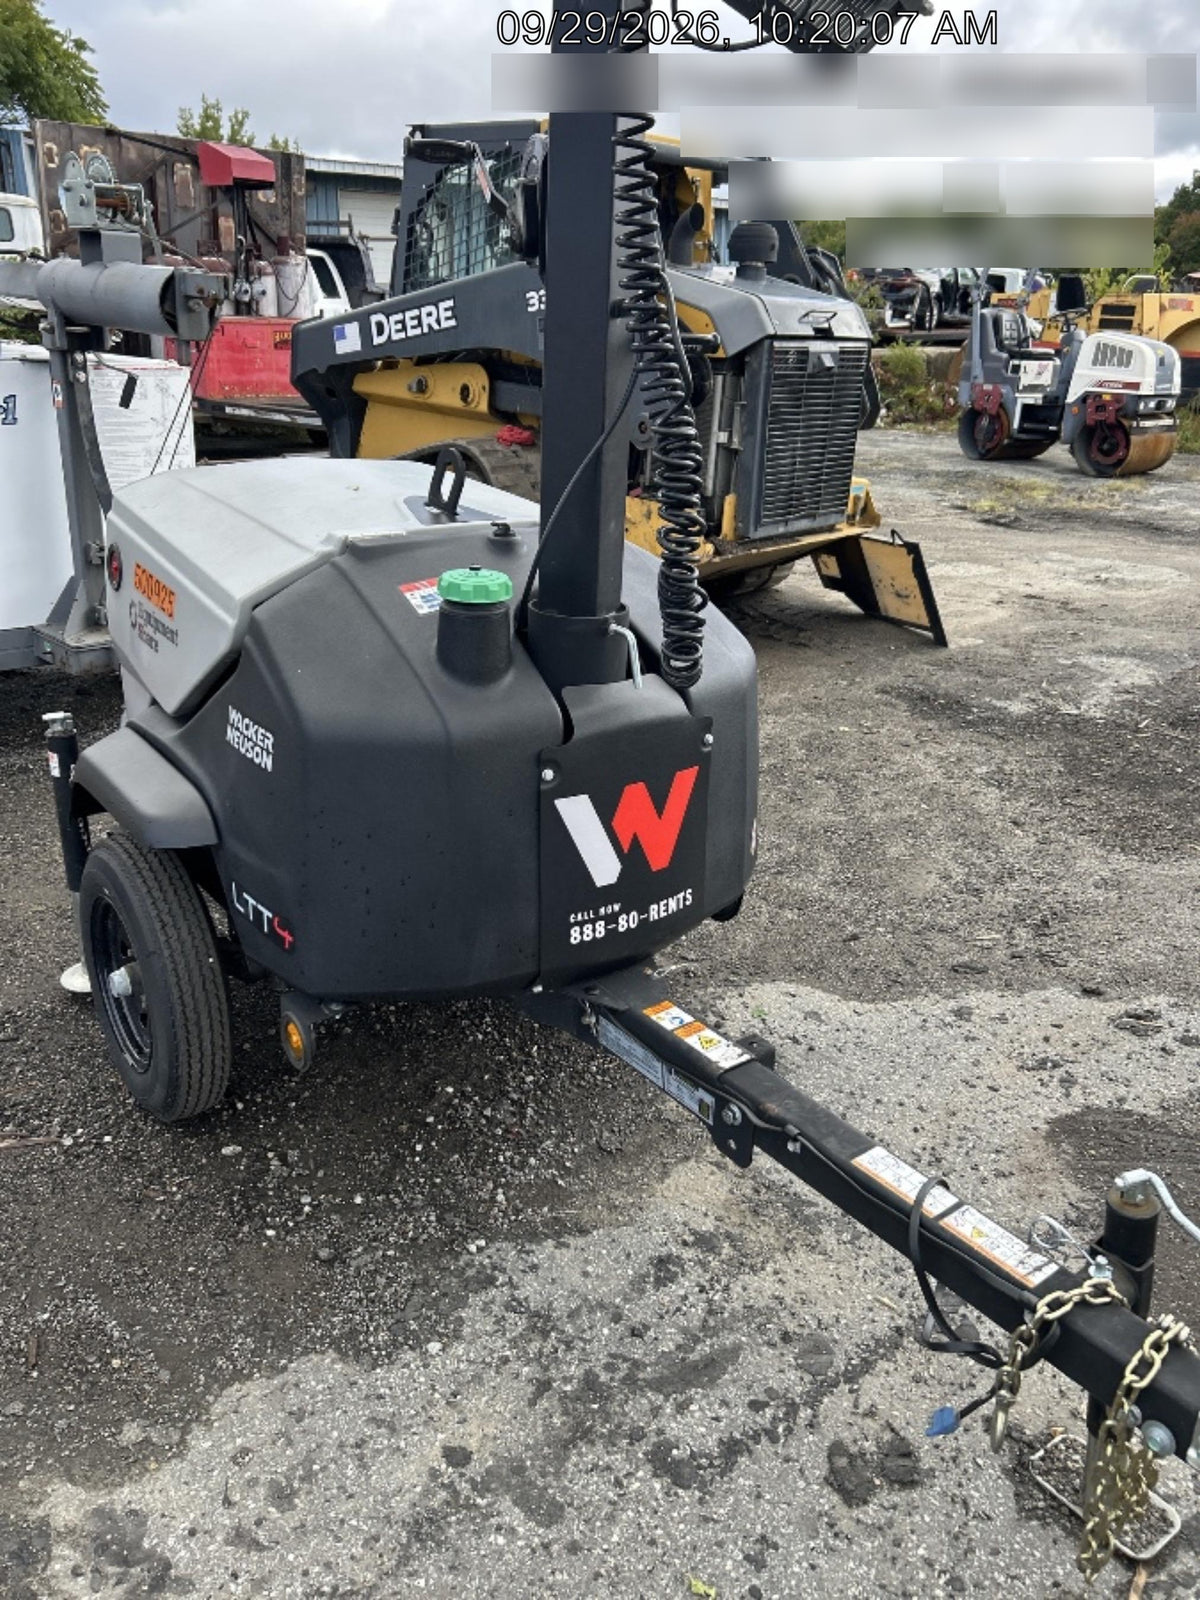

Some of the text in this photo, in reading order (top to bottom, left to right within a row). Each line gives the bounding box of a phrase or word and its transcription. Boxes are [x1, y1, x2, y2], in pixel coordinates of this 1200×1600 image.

[369, 298, 458, 346] DEERE
[225, 724, 273, 772] NEUSON
[228, 704, 274, 754] WACKER
[231, 881, 294, 950] LTT4
[569, 888, 693, 945] 888-80-RENTS
[570, 902, 622, 924] CALL NOW
